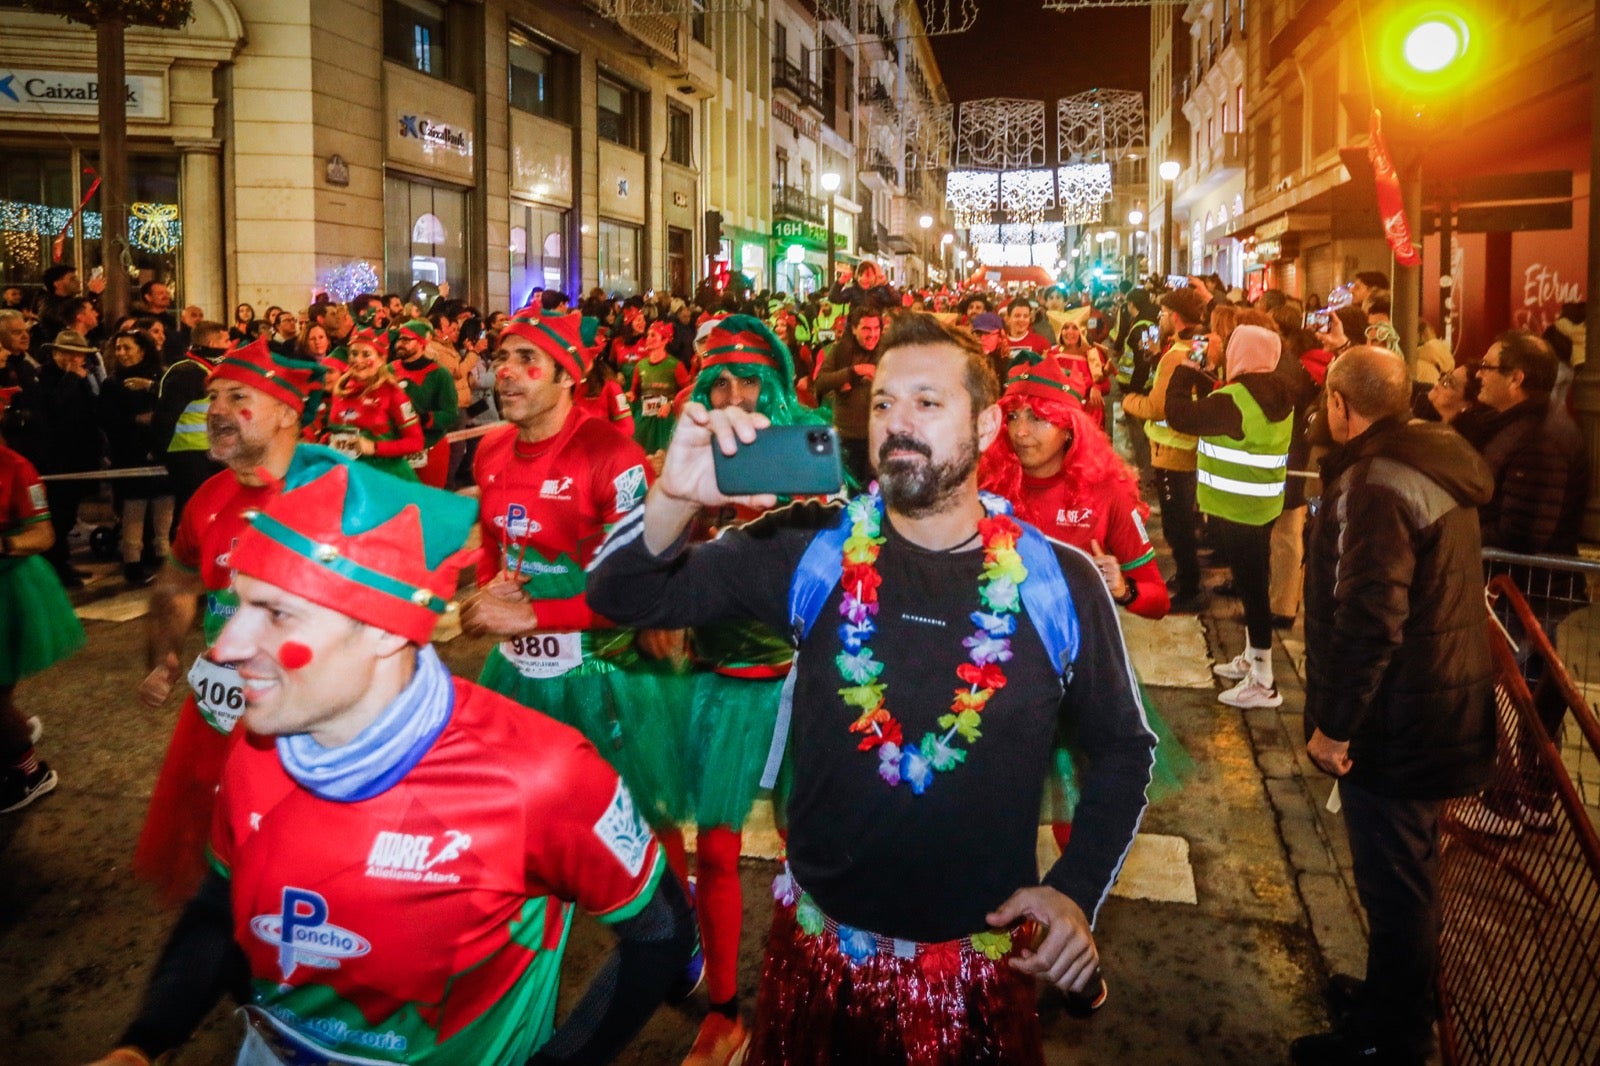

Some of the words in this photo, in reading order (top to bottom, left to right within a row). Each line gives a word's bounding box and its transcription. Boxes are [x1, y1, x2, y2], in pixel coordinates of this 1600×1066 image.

[25, 78, 138, 102] CaixaBk
[775, 223, 803, 236] 16H
[1523, 263, 1582, 307] Eterna
[511, 634, 560, 657] 980
[198, 677, 243, 710] 106
[367, 831, 434, 871] ATARFE
[281, 885, 355, 950] Poncho
